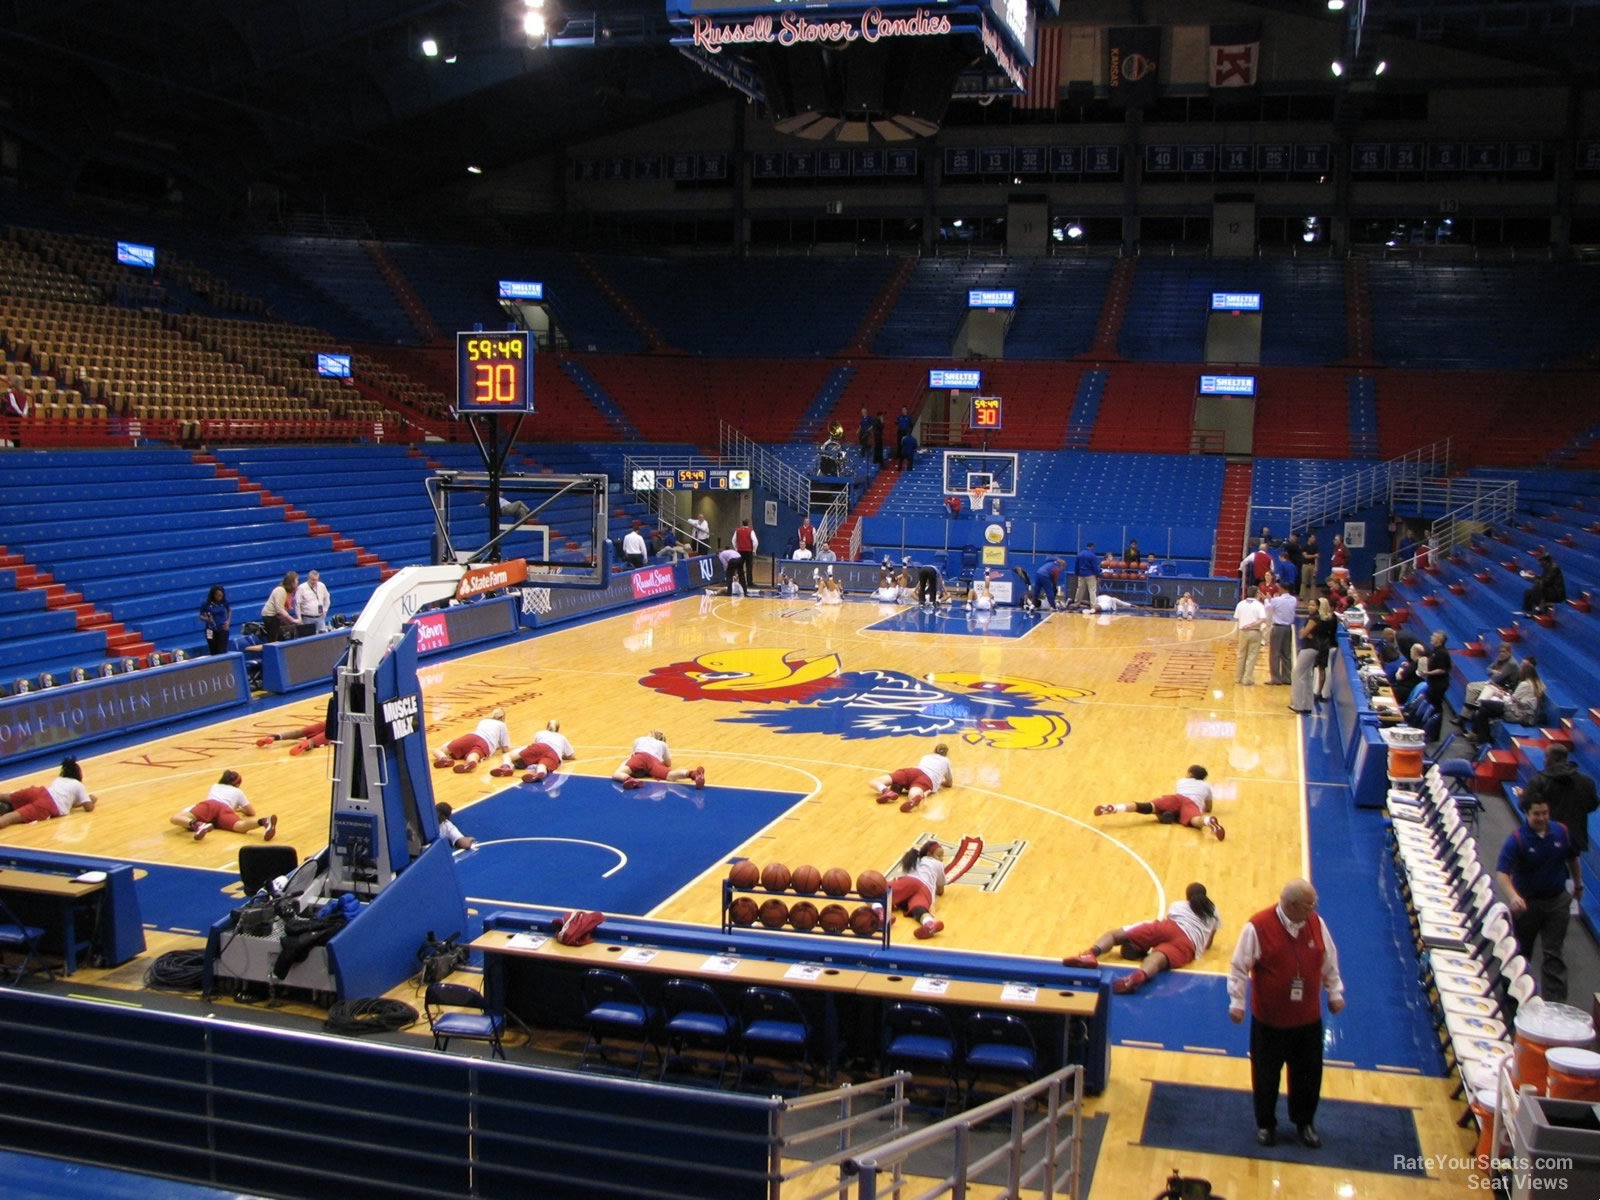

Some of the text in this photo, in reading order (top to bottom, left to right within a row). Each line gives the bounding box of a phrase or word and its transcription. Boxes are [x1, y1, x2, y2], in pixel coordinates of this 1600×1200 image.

[690, 7, 952, 53] Russell Stover Candies
[1110, 47, 1120, 88] KANSAS
[829, 157, 841, 169] 10
[862, 156, 875, 169] 15
[953, 155, 968, 168] 25
[989, 154, 1001, 167] 13
[1023, 154, 1037, 166] 32
[1060, 154, 1073, 166] 13
[1095, 154, 1108, 166] 15
[1155, 152, 1171, 165] 40
[1191, 152, 1204, 165] 15
[1230, 152, 1243, 165] 14
[1265, 152, 1282, 164] 25
[1306, 152, 1316, 164] 11
[1361, 151, 1377, 164] 45
[1397, 151, 1413, 164] 34
[1480, 151, 1488, 163] 4
[1023, 223, 1033, 233] 11
[1228, 223, 1241, 234] 12
[1226, 295, 1259, 303] SHELTER
[468, 339, 522, 361] 59:49
[944, 372, 978, 380] SHELTER
[1216, 378, 1252, 386] SHELTER
[476, 364, 515, 402] 30
[974, 399, 999, 409] 59:49
[978, 409, 996, 425] 30
[680, 471, 704, 481] 59:49
[666, 478, 673, 488] 0
[719, 478, 726, 488] 0
[699, 558, 714, 580] KU
[1098, 583, 1162, 595] WHO
[401, 594, 417, 616] KU
[58, 708, 85, 729] TO
[97, 692, 152, 720] ALLEN
[383, 695, 419, 724] MUSCLE
[338, 713, 374, 724] KANSAS
